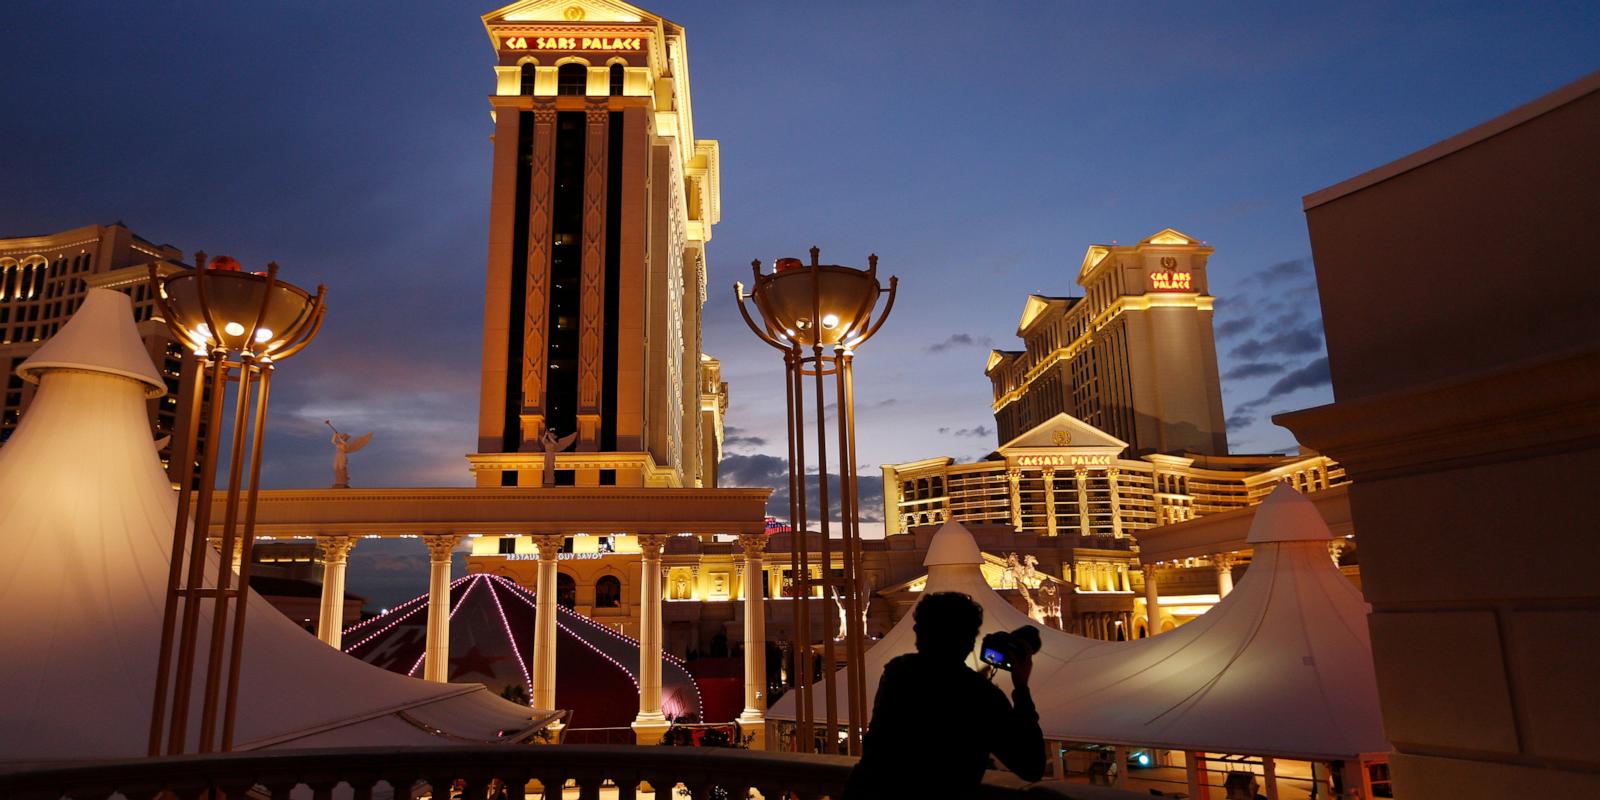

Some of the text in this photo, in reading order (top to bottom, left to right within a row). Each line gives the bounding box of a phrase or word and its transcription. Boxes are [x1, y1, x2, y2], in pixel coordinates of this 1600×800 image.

[506, 37, 641, 50] CASARS PALACE
[1151, 272, 1191, 281] CAEARS
[1153, 281, 1190, 289] PALACE
[1017, 455, 1111, 466] CAESARS PALACE
